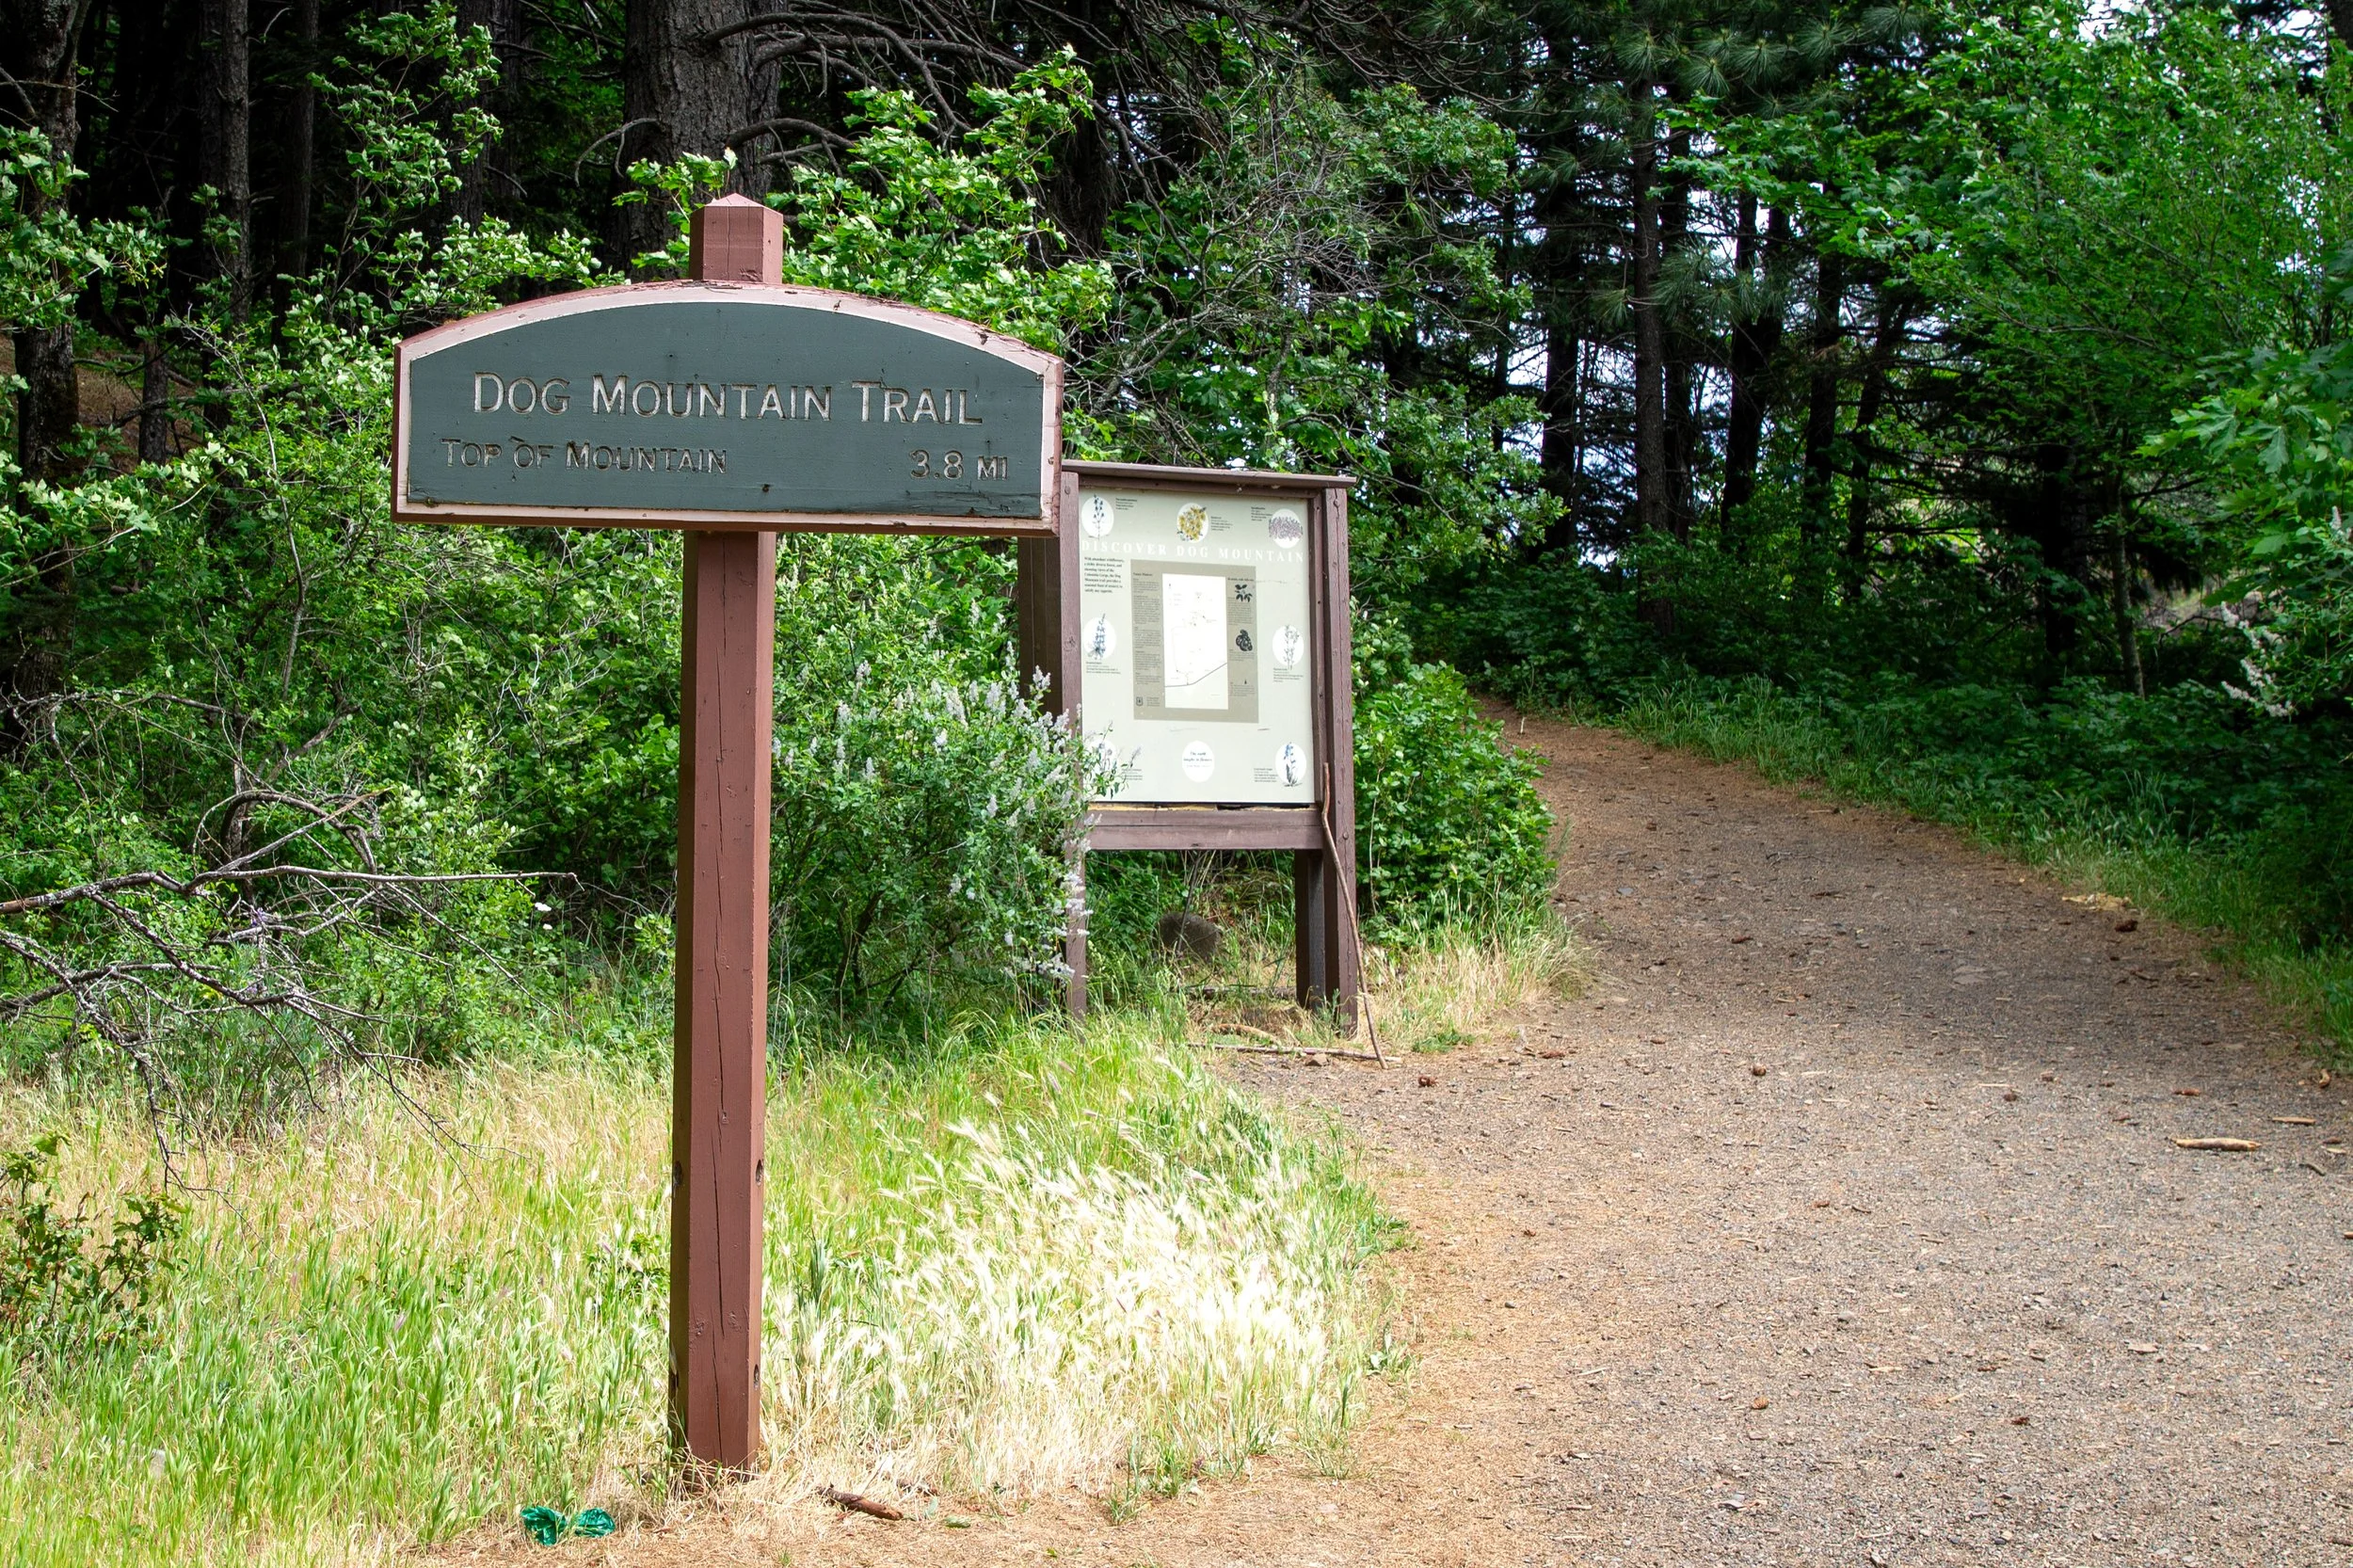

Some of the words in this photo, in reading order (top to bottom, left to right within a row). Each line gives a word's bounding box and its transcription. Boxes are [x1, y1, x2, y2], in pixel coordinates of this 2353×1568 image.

[474, 372, 570, 415] DOG
[592, 374, 832, 421] MOUNTAIN
[852, 380, 983, 424] TRAIL
[440, 438, 502, 468] TOP
[513, 443, 553, 468] OF
[567, 440, 727, 472] MOUNTAIN
[910, 449, 965, 479] 3.8
[977, 455, 1008, 480] MI
[1081, 539, 1167, 556] DISCOVER
[1176, 545, 1209, 559] DOG
[1218, 548, 1305, 564] MOUNTAIN
